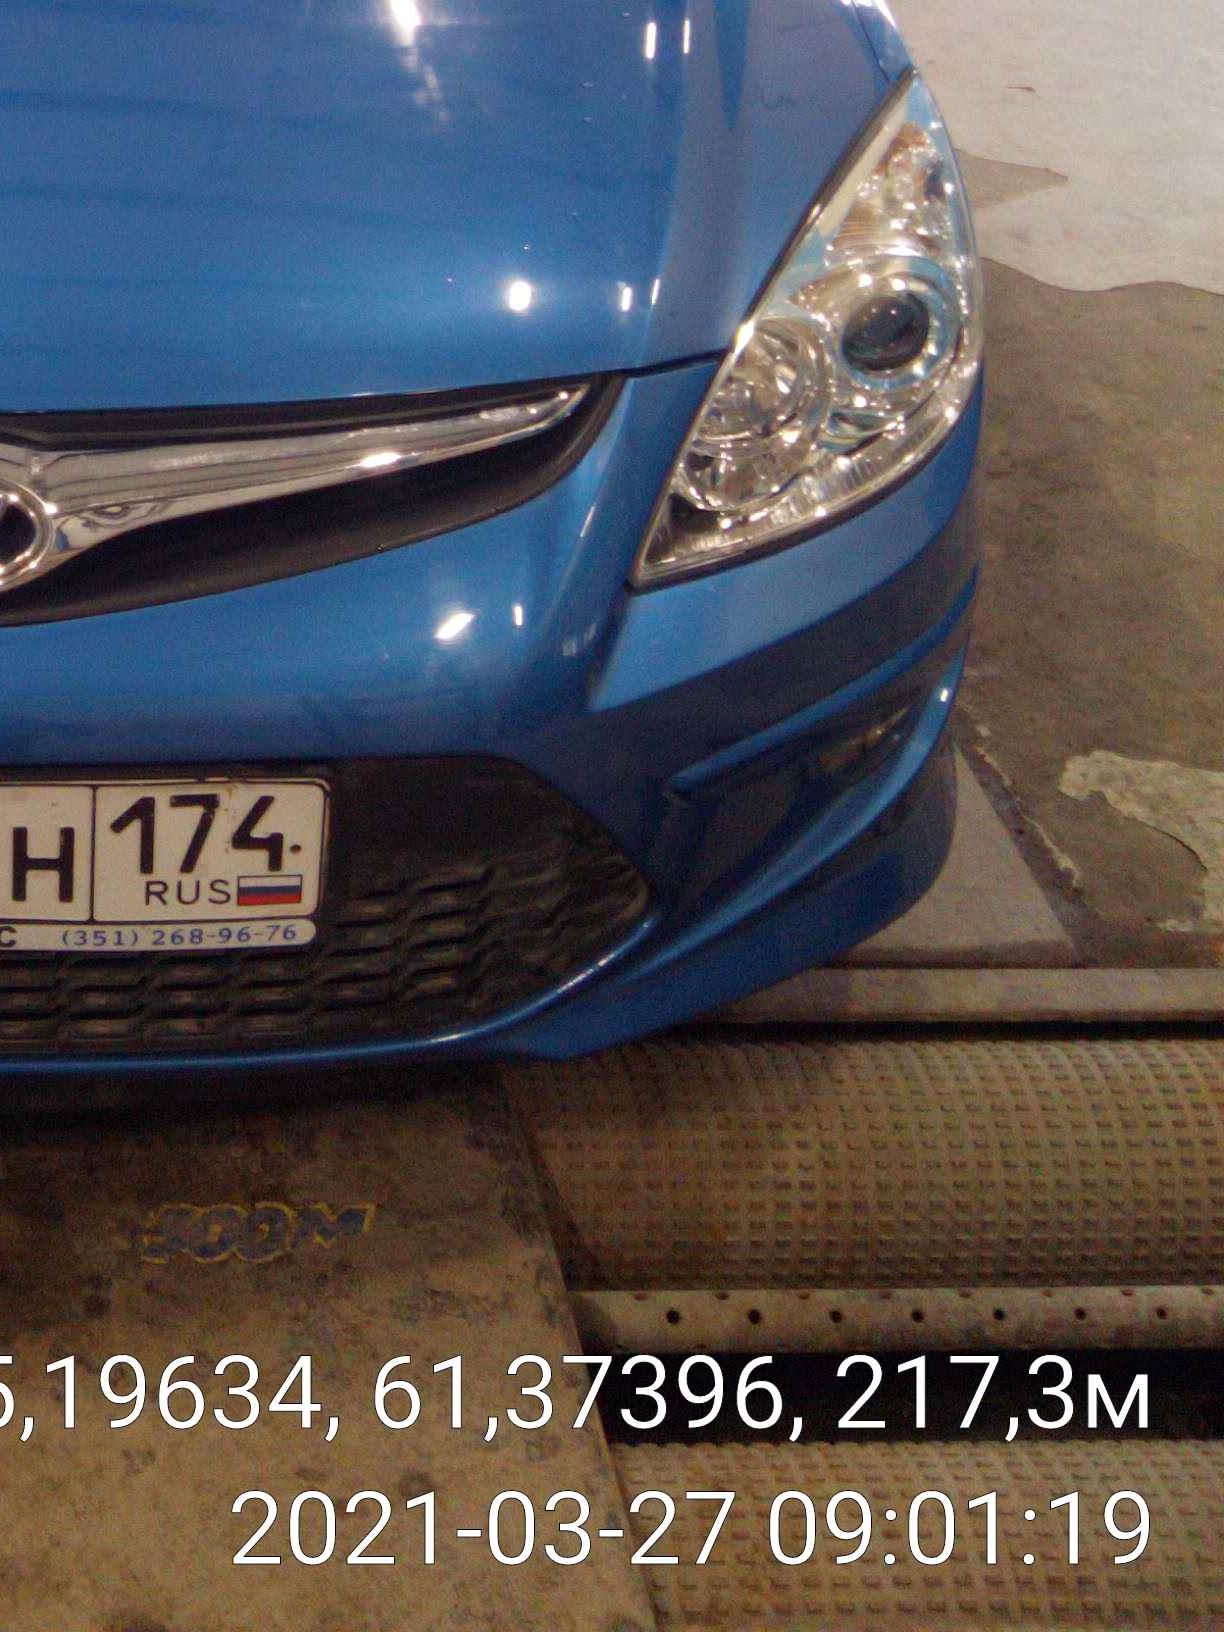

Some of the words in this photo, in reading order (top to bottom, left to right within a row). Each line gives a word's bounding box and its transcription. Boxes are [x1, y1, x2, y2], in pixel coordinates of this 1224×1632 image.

[109, 793, 284, 874] 174
[144, 878, 232, 906] RUS
[61, 929, 139, 947] (351)
[152, 924, 297, 946] 268-96-76
